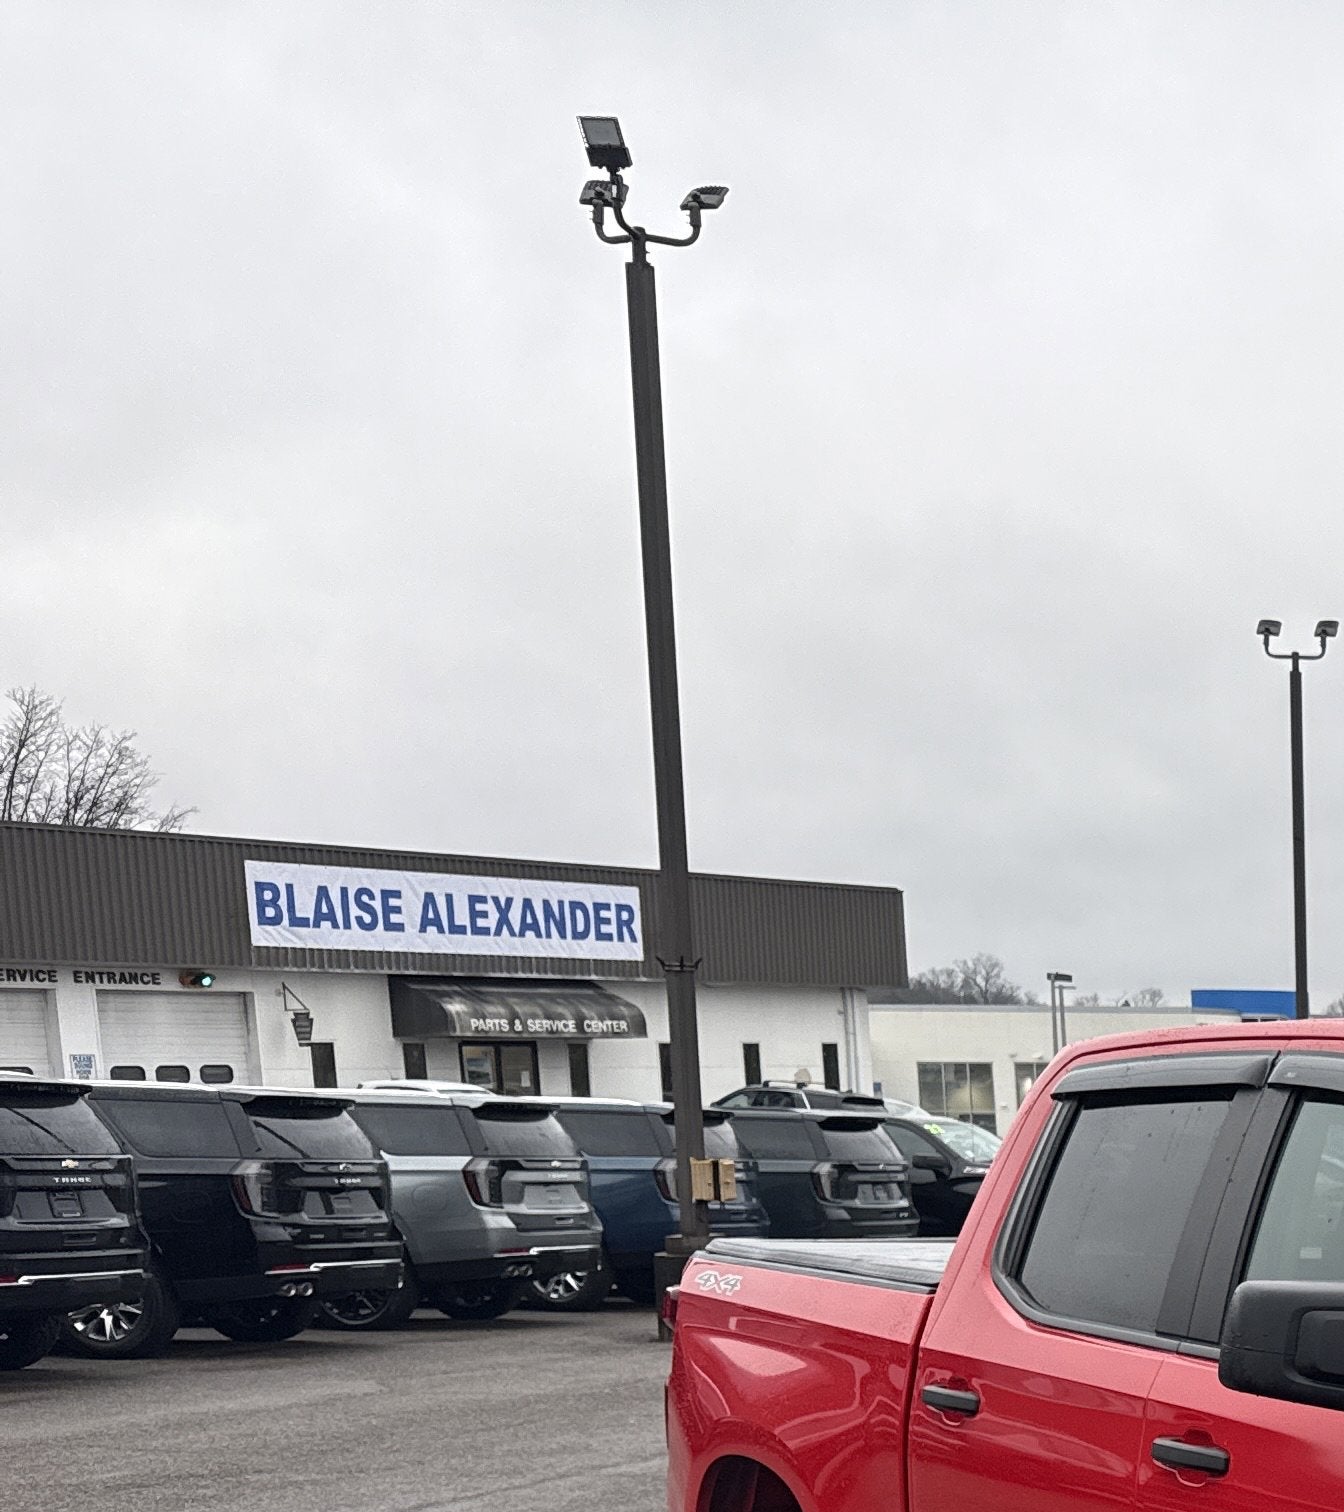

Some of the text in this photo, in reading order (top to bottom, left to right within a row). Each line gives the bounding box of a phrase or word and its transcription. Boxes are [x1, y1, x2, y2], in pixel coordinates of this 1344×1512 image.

[254, 880, 639, 944] BLAISE ALEXANDER
[73, 970, 162, 985] ENTRANCE
[470, 1017, 629, 1034] PARTS & SERVICE CENTER
